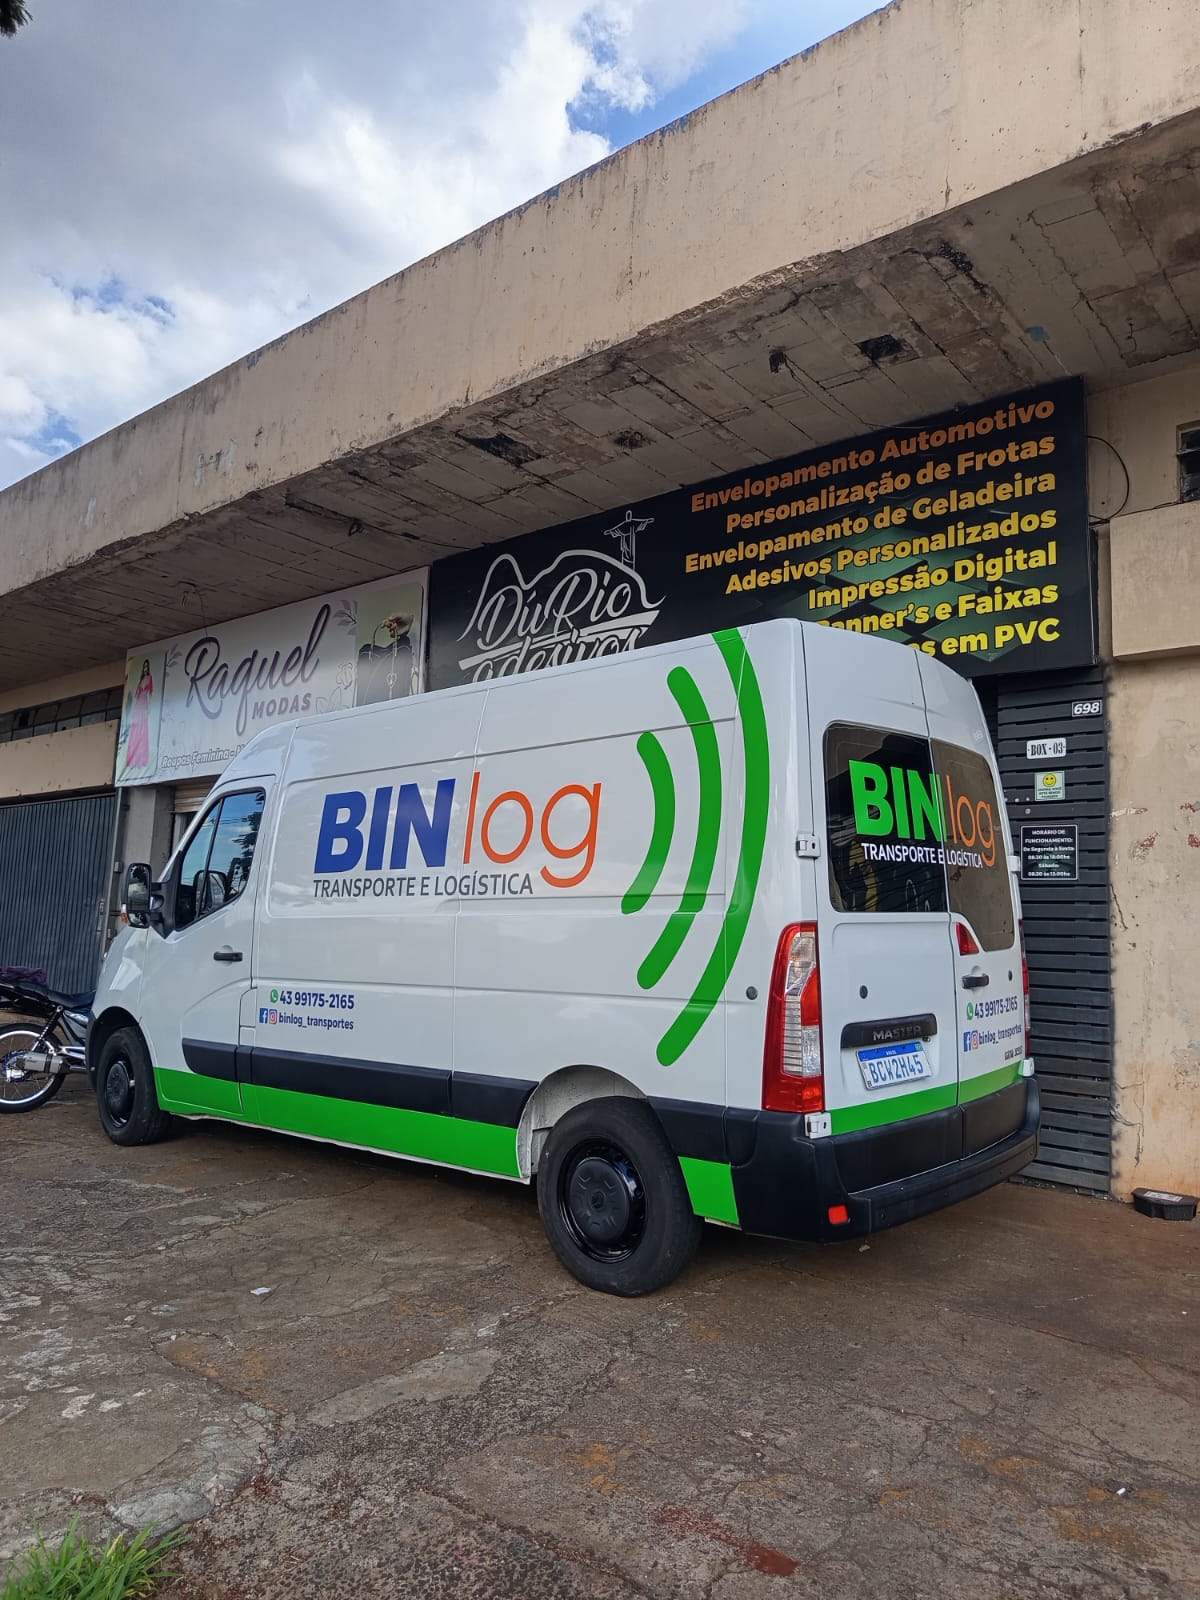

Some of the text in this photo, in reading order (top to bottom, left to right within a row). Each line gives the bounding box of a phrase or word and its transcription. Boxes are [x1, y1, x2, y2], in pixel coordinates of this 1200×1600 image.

[691, 399, 1055, 513] Envelopamento Automotivo
[726, 436, 1056, 533] Personalização de Frotas
[685, 472, 1056, 573] Envelopamento de Geladeira
[725, 508, 1057, 595] Adesivos Personalizados
[808, 541, 1058, 610] Impressão Digital
[816, 584, 1059, 634] nner's e Faixas
[942, 627, 988, 655] em
[995, 617, 1061, 649] PVC
[184, 603, 331, 737] Raquel
[252, 693, 312, 720] MODAS
[1074, 702, 1100, 715] 698
[1030, 742, 1063, 756] BOX 03
[861, 843, 983, 869] TRANSPORTE E LOGÍSTICA
[313, 870, 534, 898] TRANSPORTE E LOGÍSTICA
[279, 990, 355, 1009] 43 99175-2165
[974, 996, 1018, 1018] 43 99175-2165
[279, 1012, 354, 1030] binlog_transportes
[873, 1026, 921, 1040] MASTER
